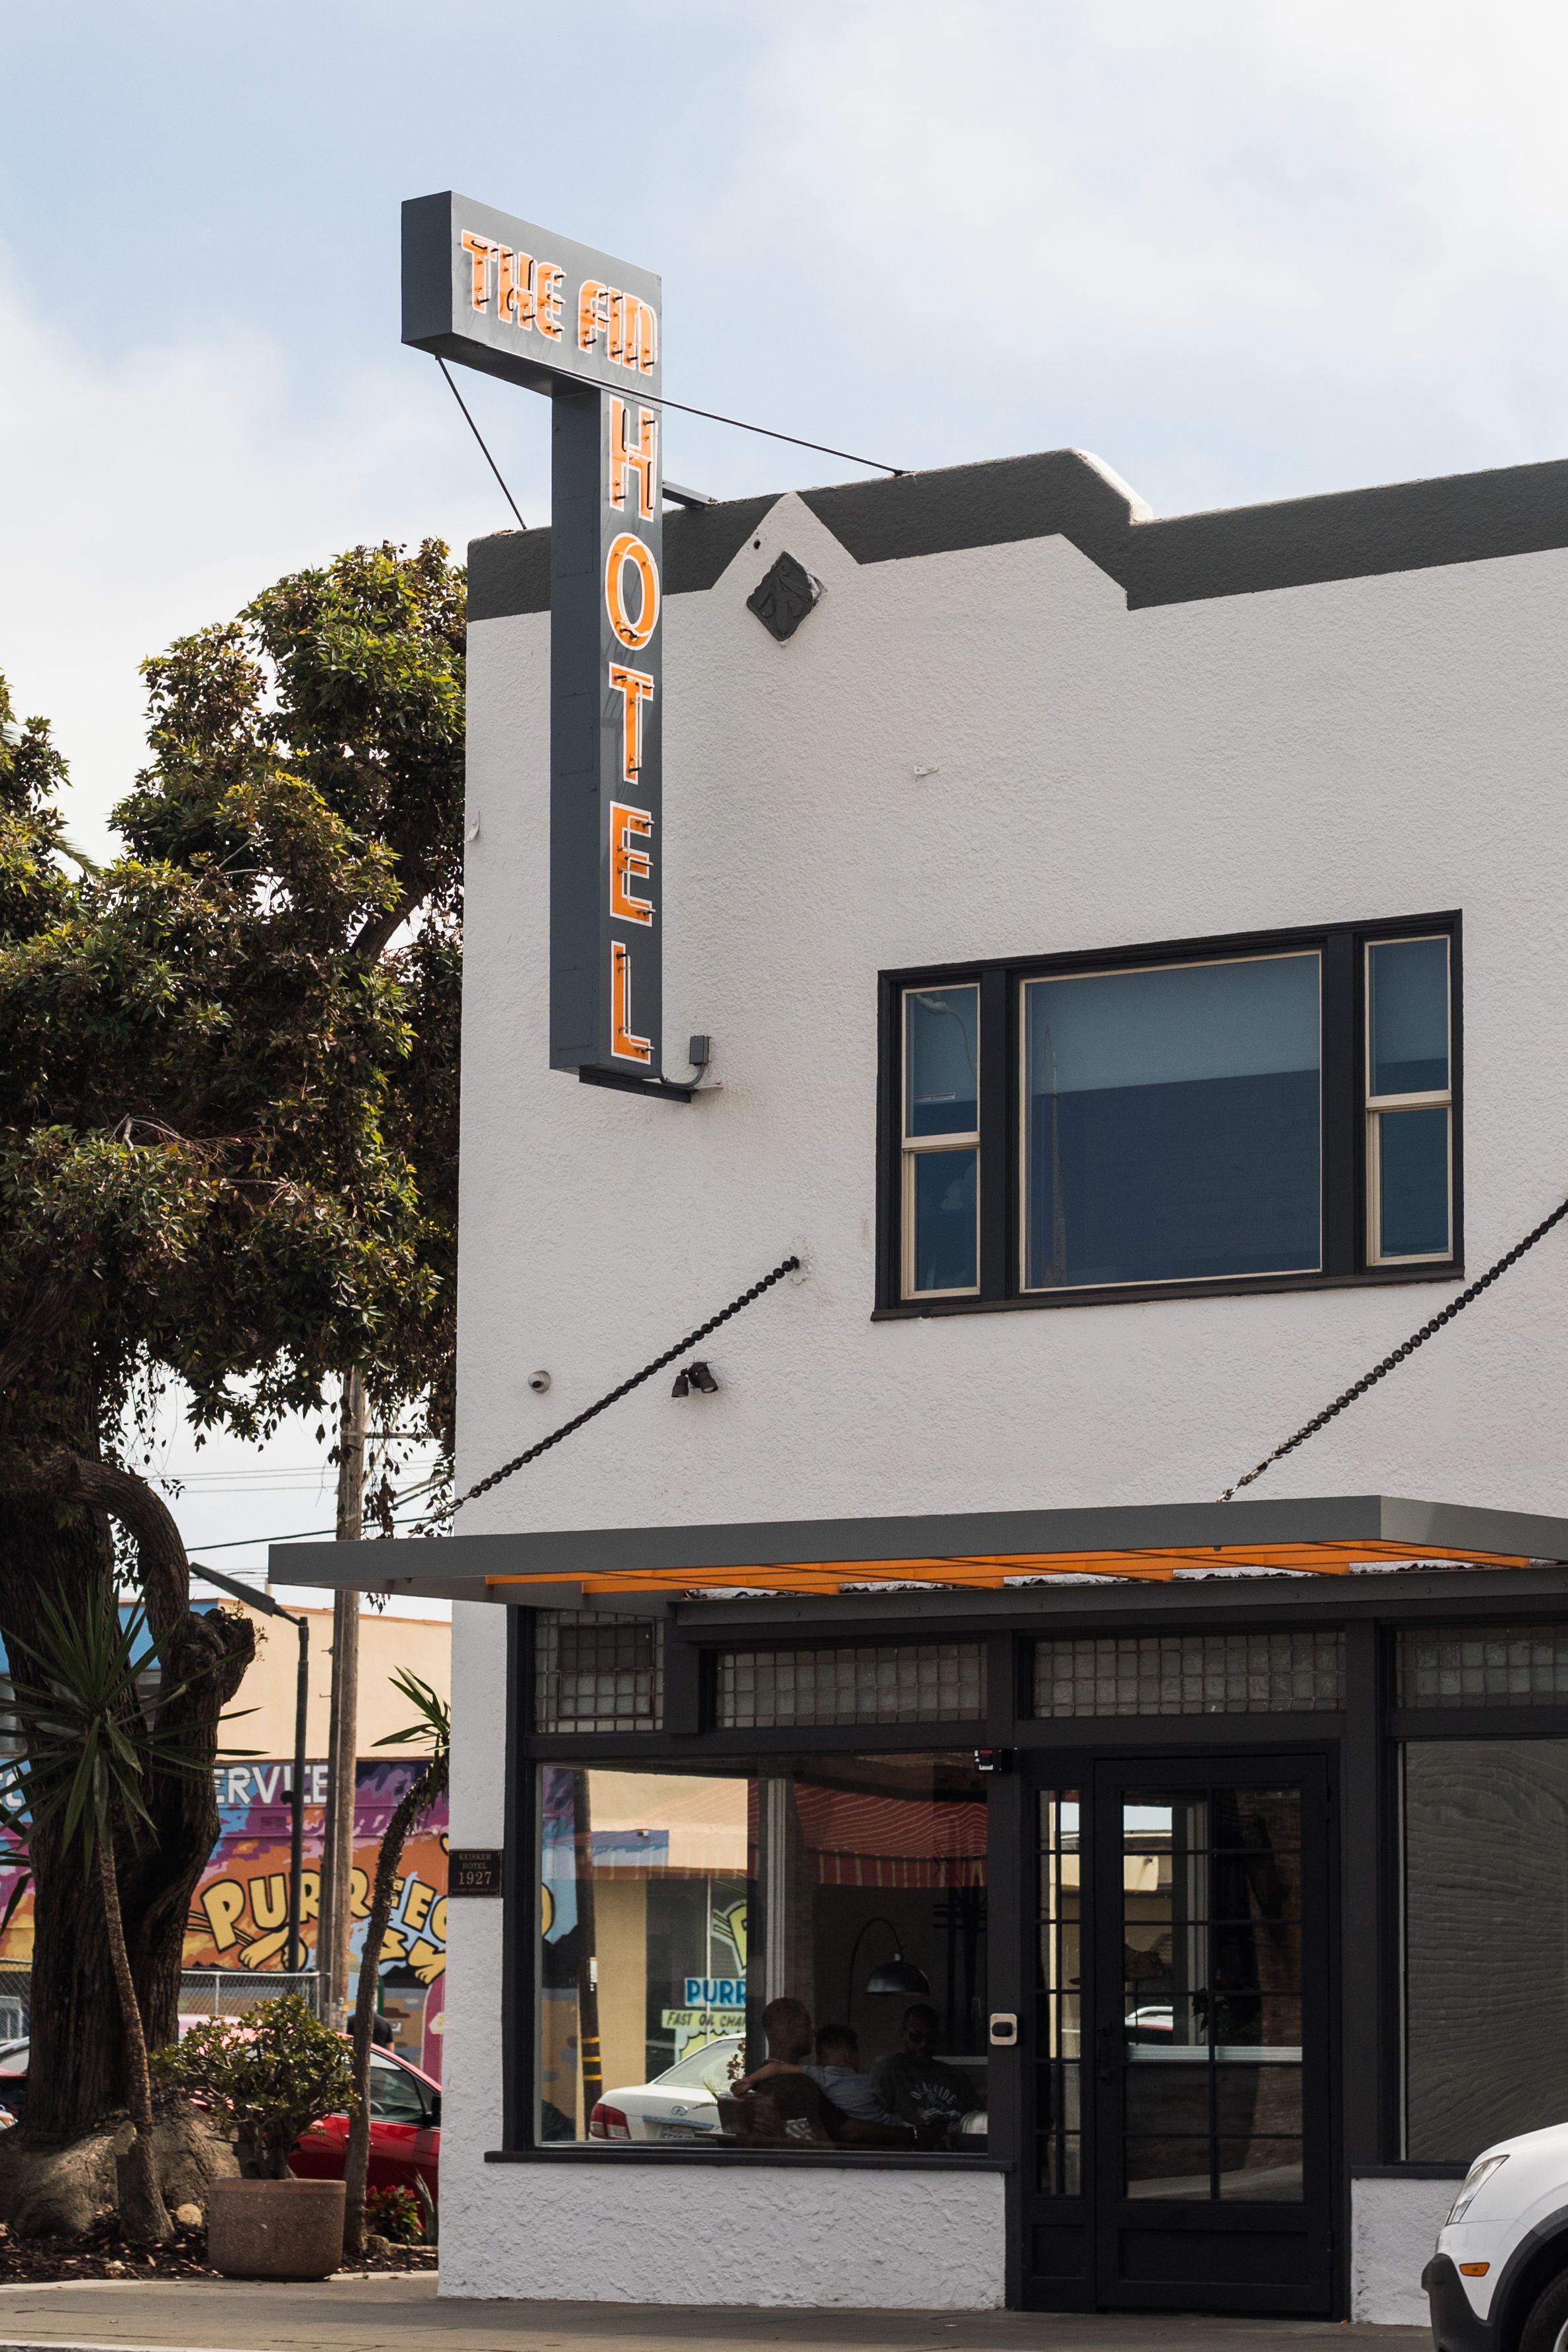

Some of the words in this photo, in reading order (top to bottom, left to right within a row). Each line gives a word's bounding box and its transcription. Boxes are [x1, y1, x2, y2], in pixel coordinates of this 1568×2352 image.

[461, 228, 567, 343] THE
[577, 279, 658, 377] FIN
[604, 394, 660, 1065] HOTEL
[458, 1871, 493, 1886] 1927
[666, 2010, 693, 2026] FAST
[719, 2014, 746, 2028] CHA
